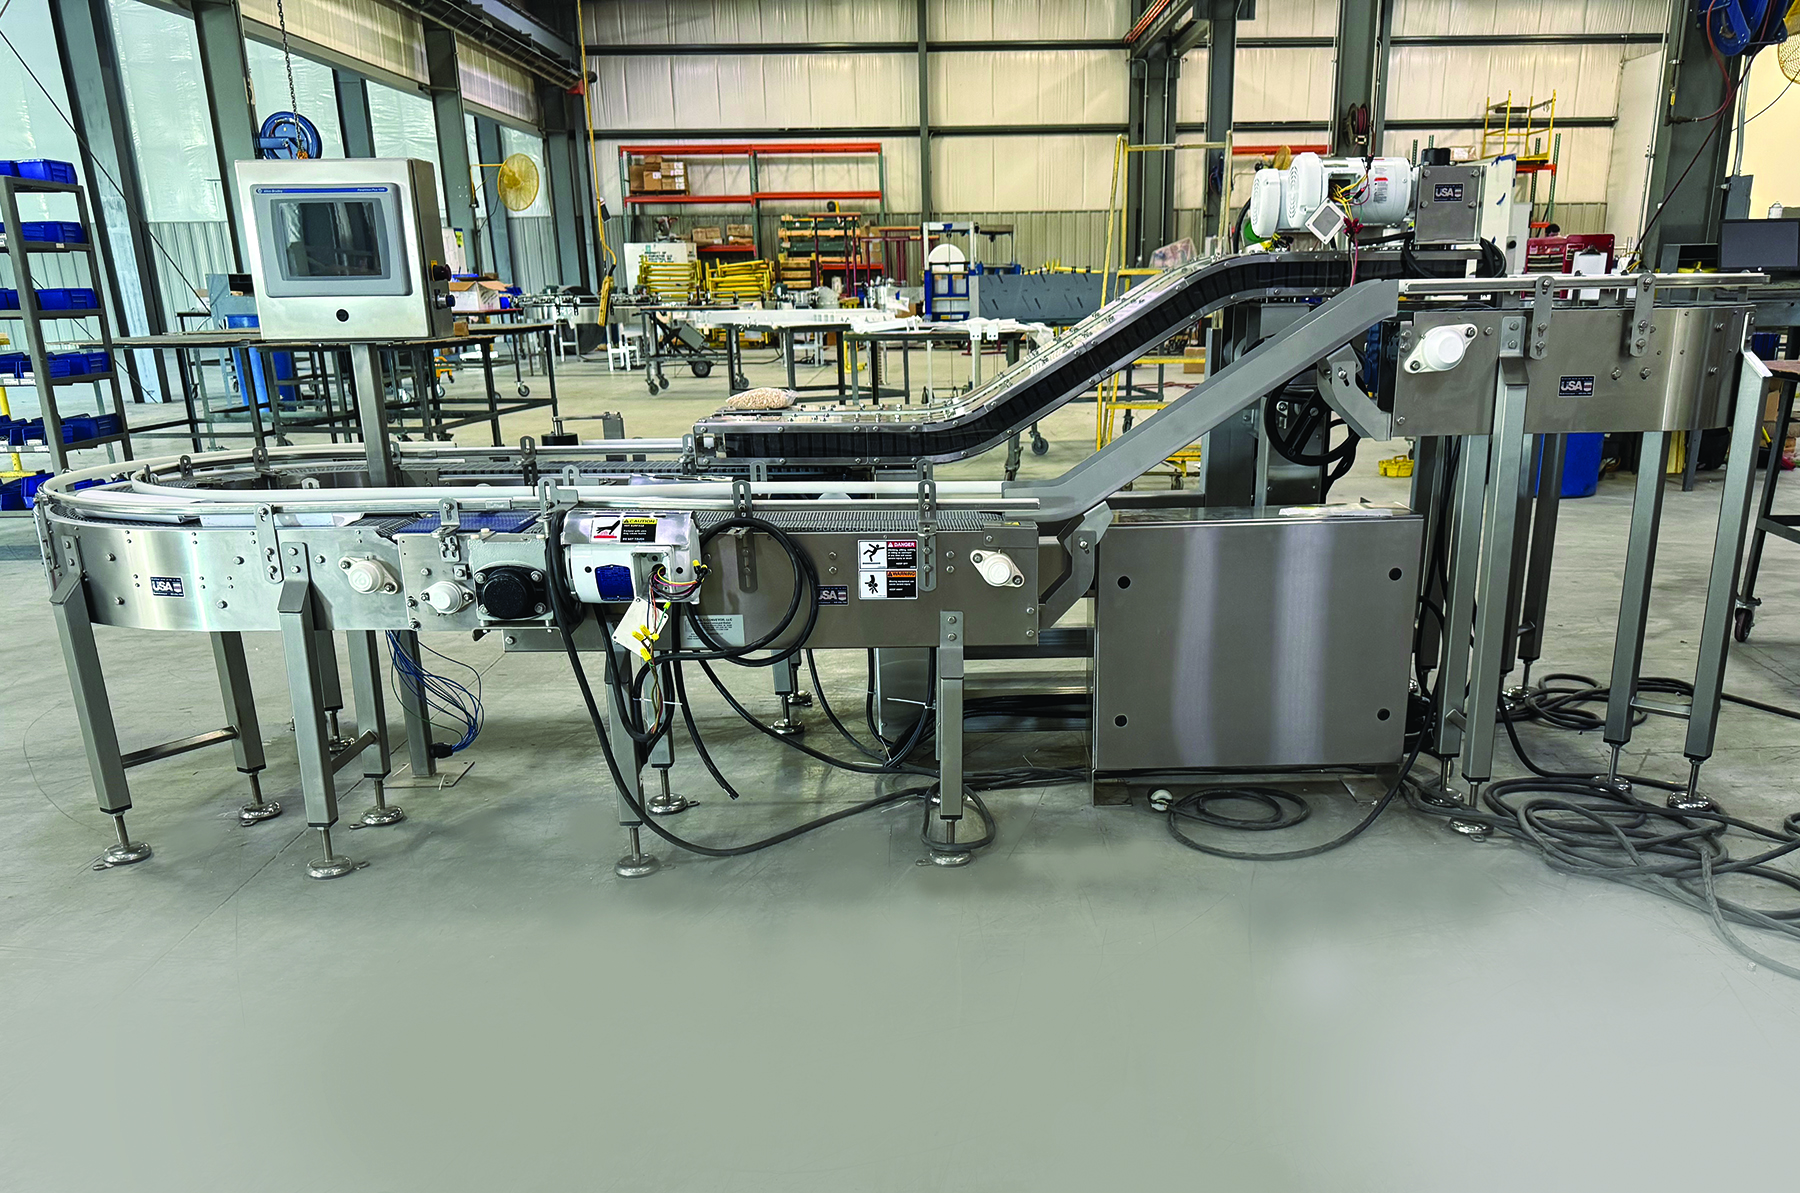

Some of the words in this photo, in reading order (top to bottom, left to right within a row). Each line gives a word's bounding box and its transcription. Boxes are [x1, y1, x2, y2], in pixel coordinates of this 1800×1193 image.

[1435, 187, 1454, 197] USA
[1560, 380, 1583, 391] USA
[152, 581, 173, 591] USA
